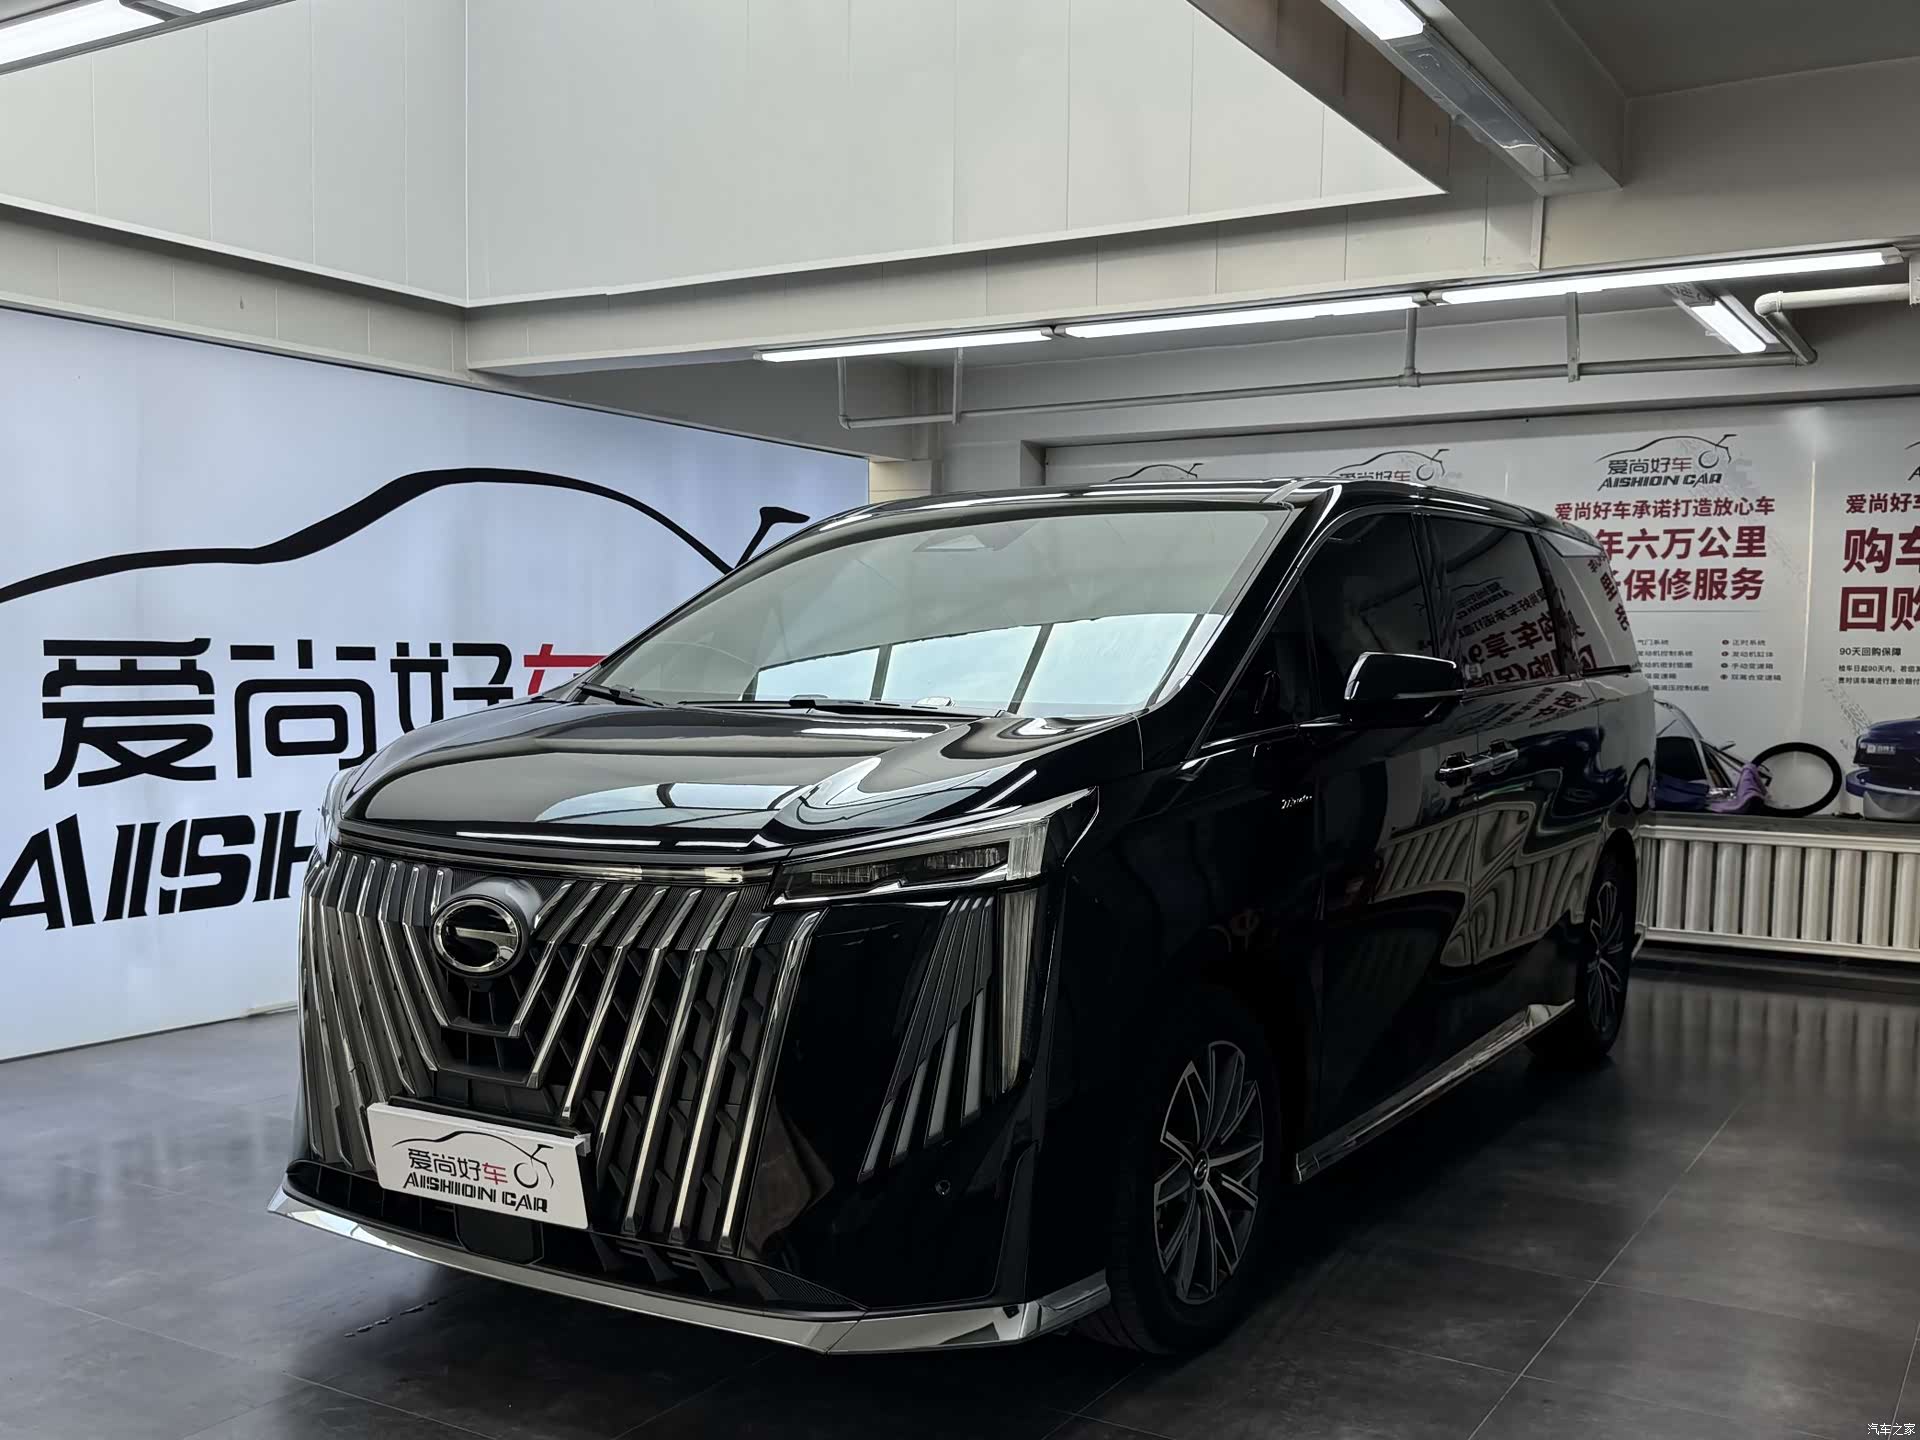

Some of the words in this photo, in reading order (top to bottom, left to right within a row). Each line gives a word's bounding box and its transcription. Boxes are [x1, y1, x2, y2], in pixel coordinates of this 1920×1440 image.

[1607, 457, 1692, 475] 爱尚好车
[1598, 475, 1681, 491] AISHION
[1683, 473, 1723, 488] CAR
[1555, 496, 1776, 521] 爱尚好车承诺打造放心车
[1839, 647, 1902, 656] 90天回购保障
[408, 1147, 508, 1185] 爱尚好车
[403, 1171, 497, 1203] AISHION
[502, 1190, 549, 1214] CAR
